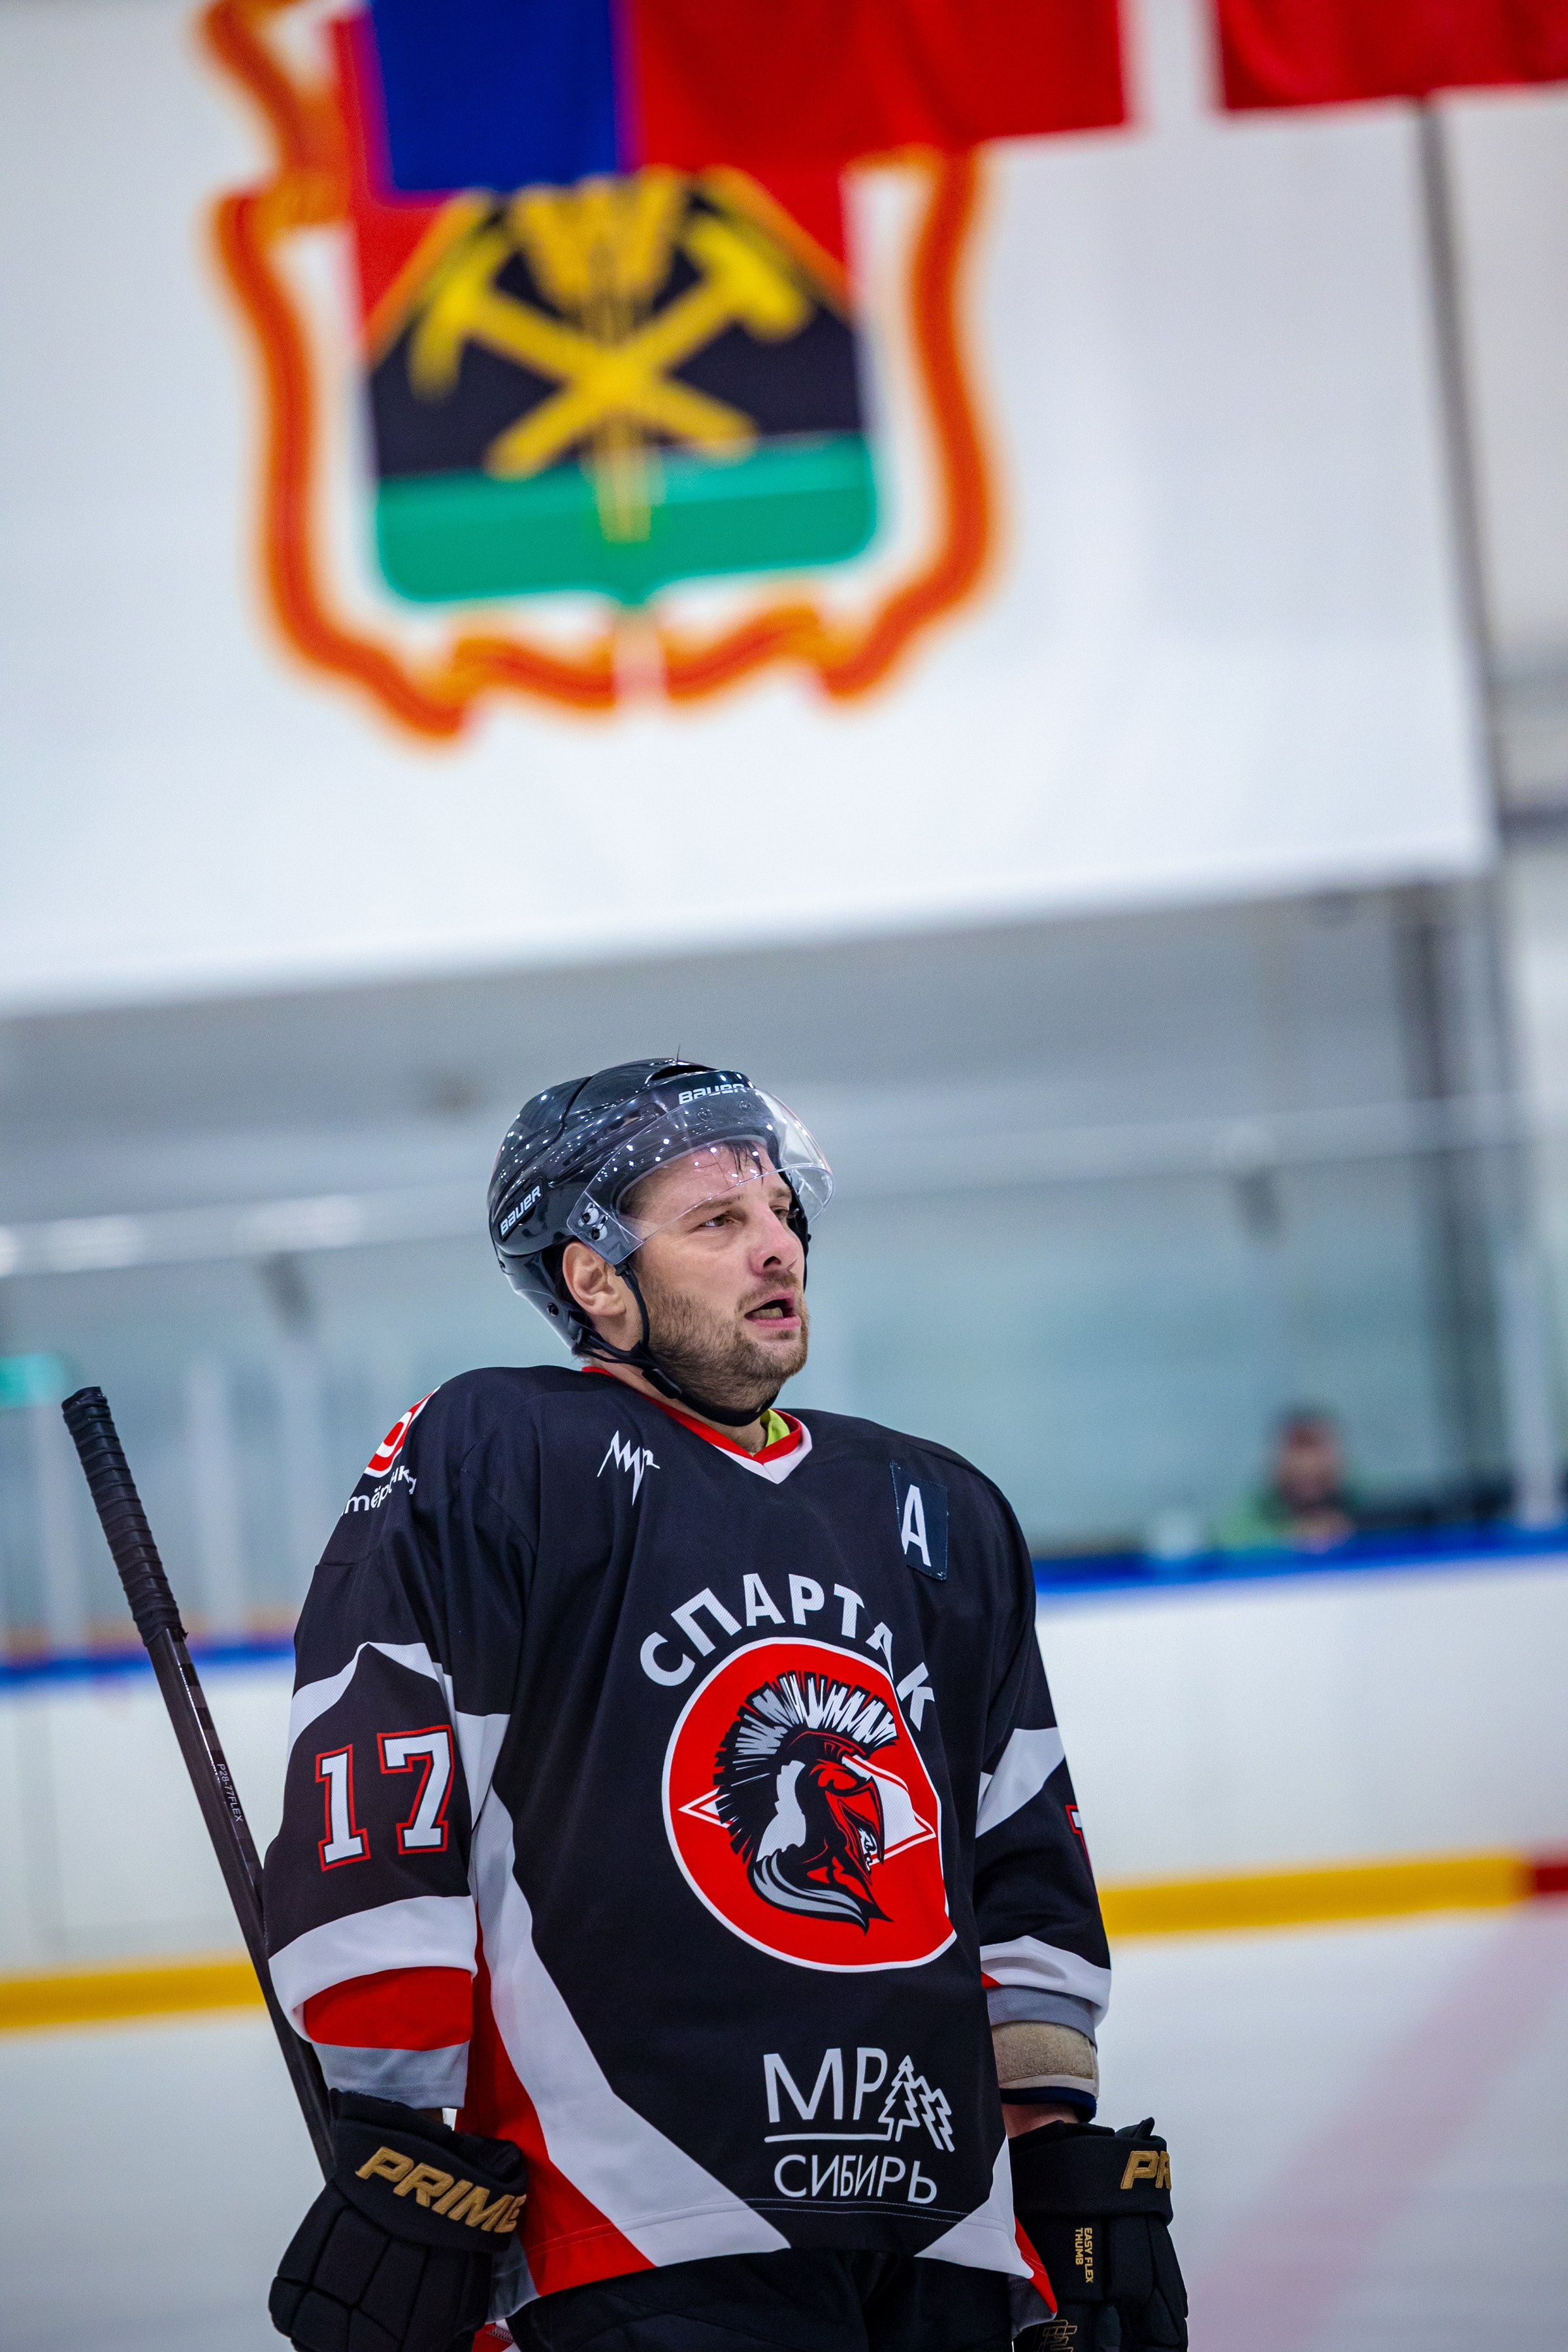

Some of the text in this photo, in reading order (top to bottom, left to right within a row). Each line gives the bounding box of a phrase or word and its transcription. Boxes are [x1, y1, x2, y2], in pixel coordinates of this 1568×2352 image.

[500, 1185, 542, 1236] BAUER
[639, 1572, 936, 1732] СПАРТАК
[314, 1723, 455, 1872] 17
[774, 2154, 938, 2204] СИБИРЬ
[1075, 2227, 1084, 2265] THUMB
[1084, 2227, 1094, 2283] EASY FLEX
